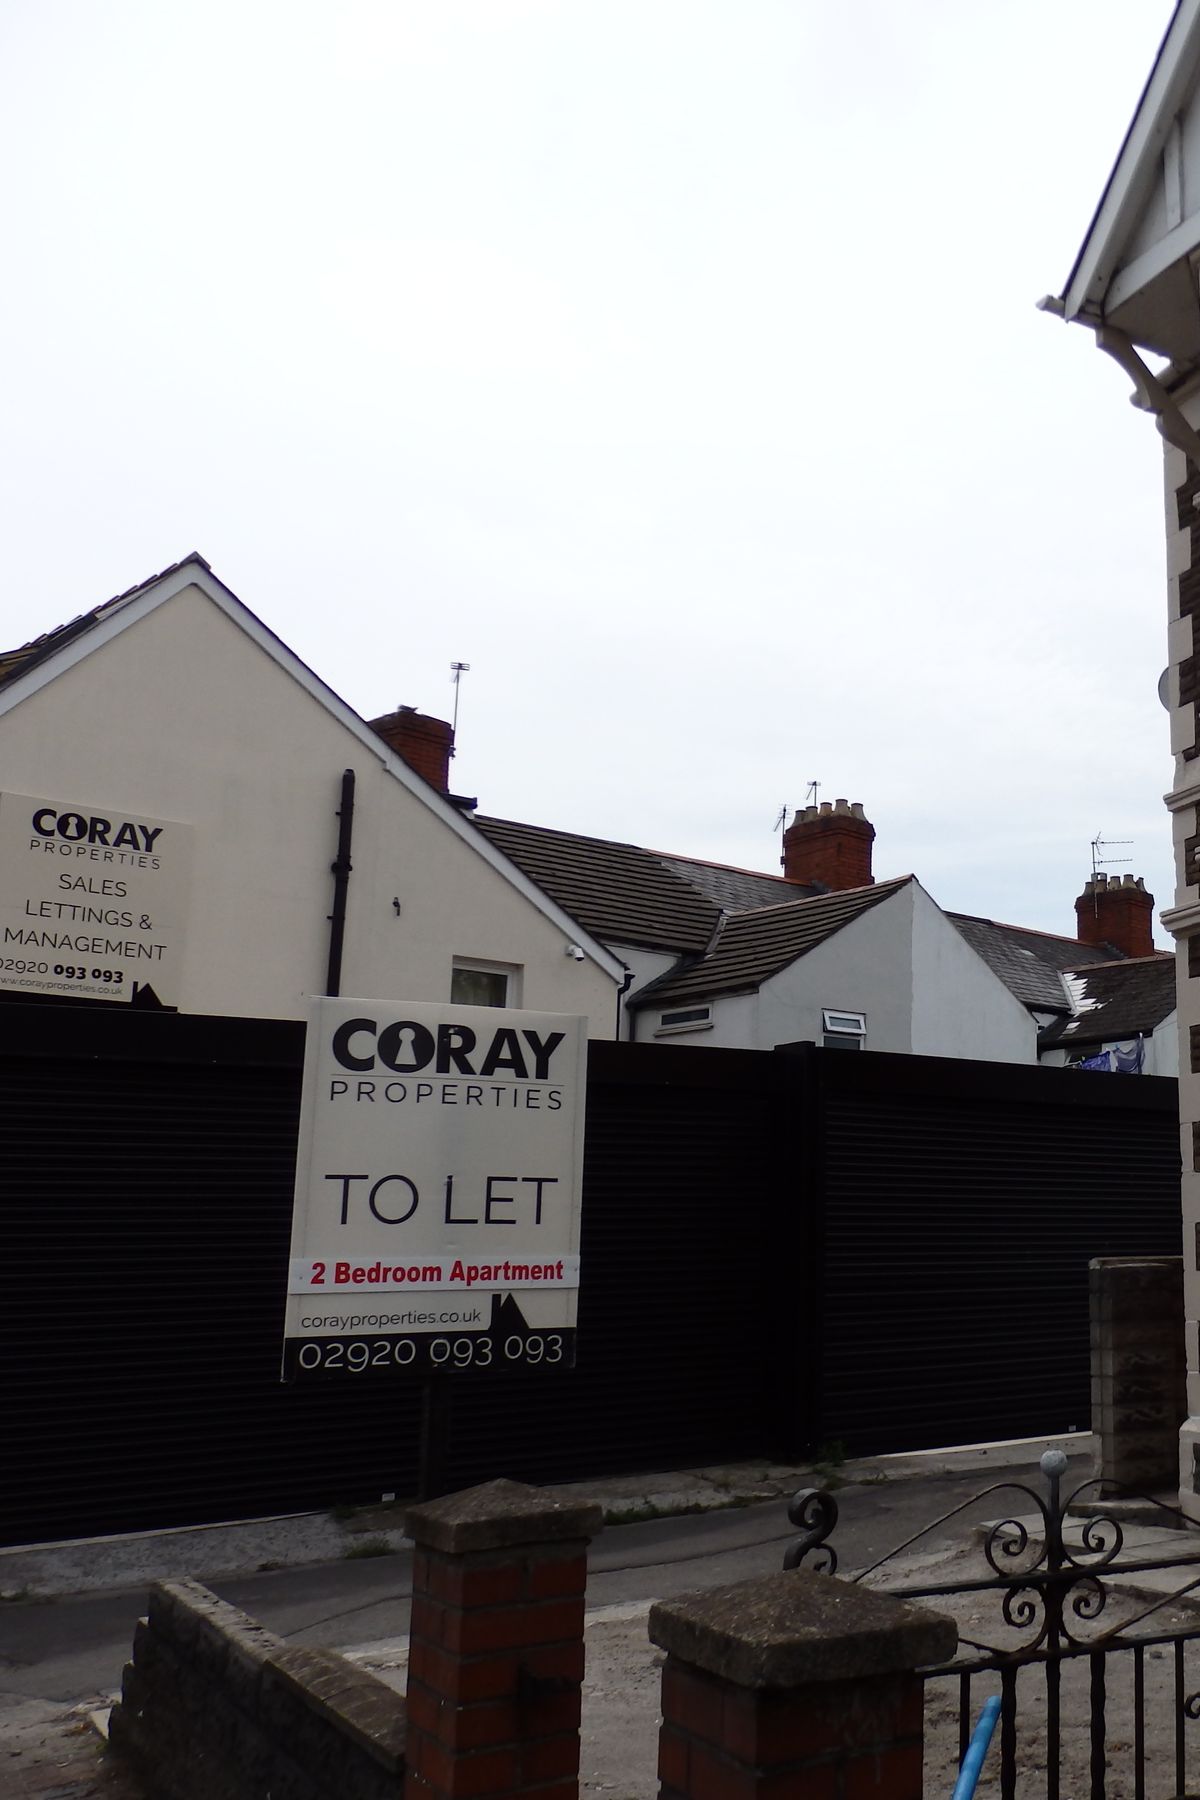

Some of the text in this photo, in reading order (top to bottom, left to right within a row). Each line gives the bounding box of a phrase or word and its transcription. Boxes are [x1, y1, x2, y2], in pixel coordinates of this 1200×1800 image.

[32, 807, 164, 853] CORAY
[29, 838, 161, 870] PROPERTIES
[58, 873, 128, 898] SALES
[25, 899, 153, 930] LETTINGS &
[4, 927, 168, 961] MANAGEMENT
[53, 964, 87, 980] 093
[91, 968, 124, 984] 093
[331, 1017, 567, 1080] CORAY
[330, 1080, 563, 1110] PROPERTIES
[324, 1173, 559, 1226] TO LET
[310, 1260, 564, 1286] 2 Bedroom Apartment
[301, 1309, 482, 1331] corayproperties.co.uk
[299, 1334, 563, 1373] 02920 093 093
